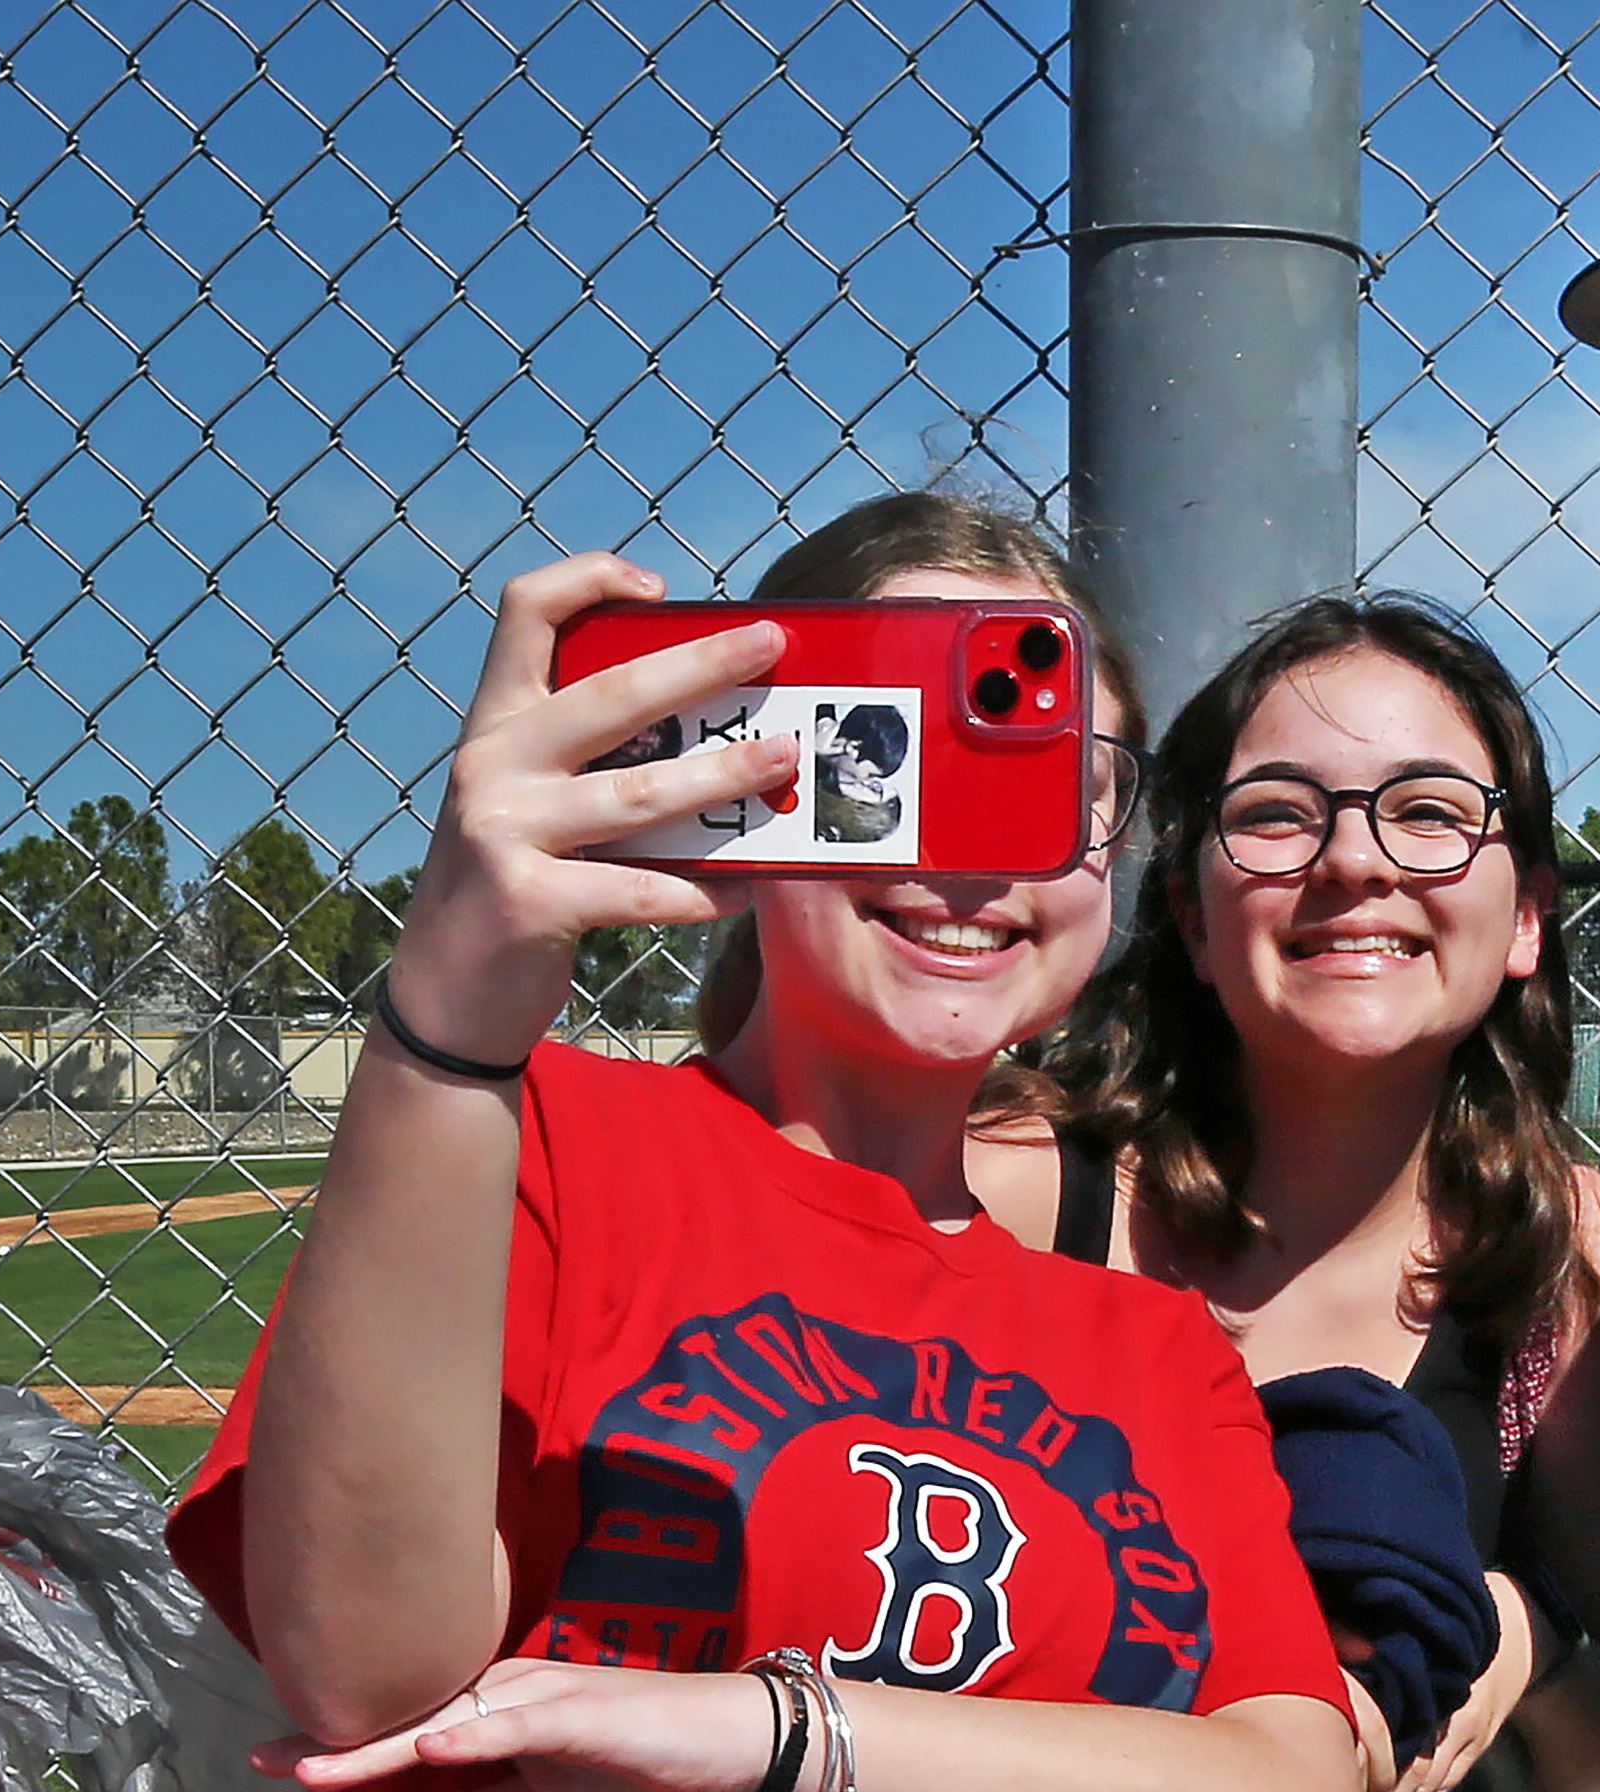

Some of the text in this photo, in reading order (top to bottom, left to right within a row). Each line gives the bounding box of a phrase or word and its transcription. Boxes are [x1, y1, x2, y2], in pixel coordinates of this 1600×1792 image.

[587, 1313, 1202, 1672] BOSTON RED SOX
[820, 1443, 1029, 1694] B
